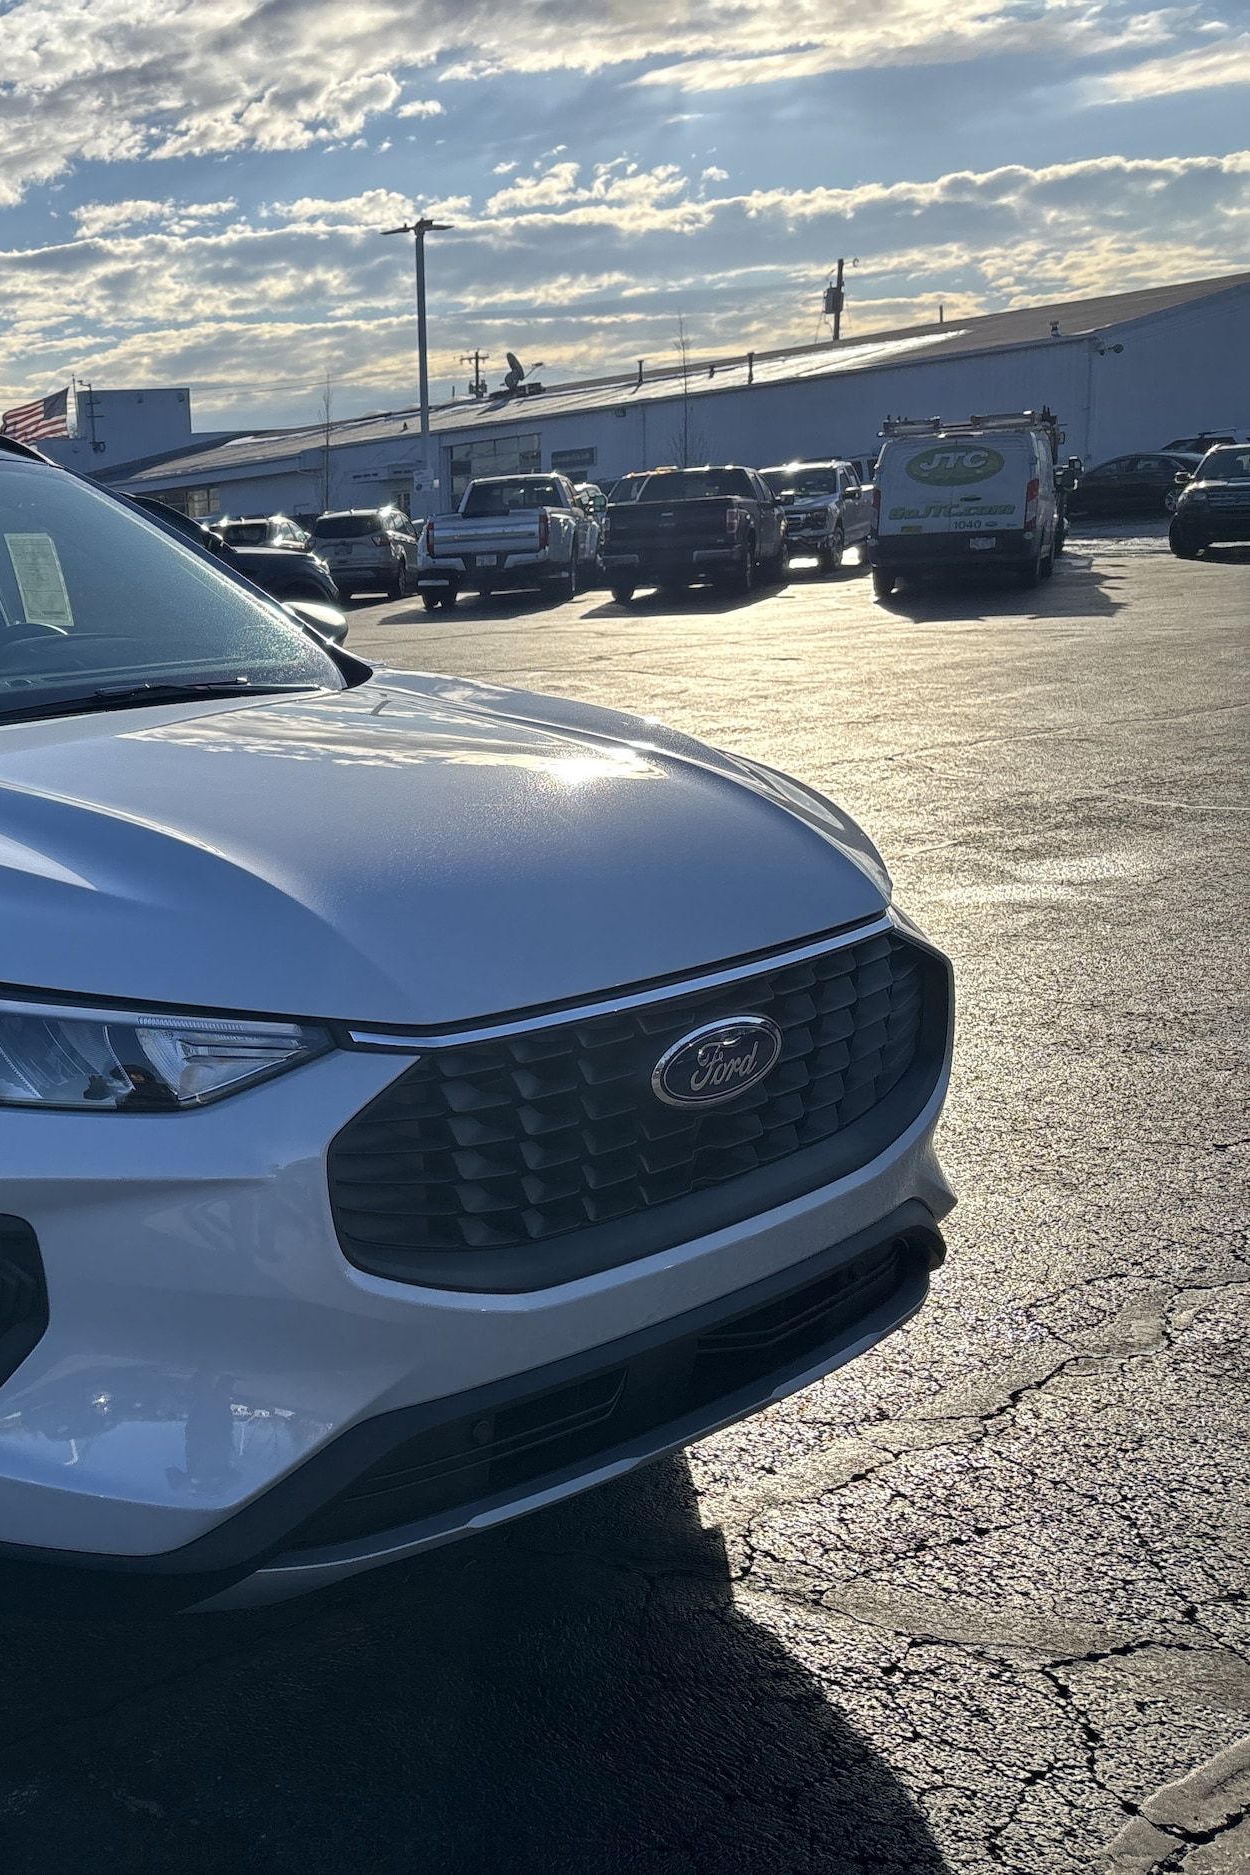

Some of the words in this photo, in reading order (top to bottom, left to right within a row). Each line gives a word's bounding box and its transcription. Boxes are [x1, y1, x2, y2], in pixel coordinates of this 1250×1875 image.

[920, 449, 989, 471] JTC
[953, 520, 982, 530] 1040
[690, 1036, 759, 1092] Ford
